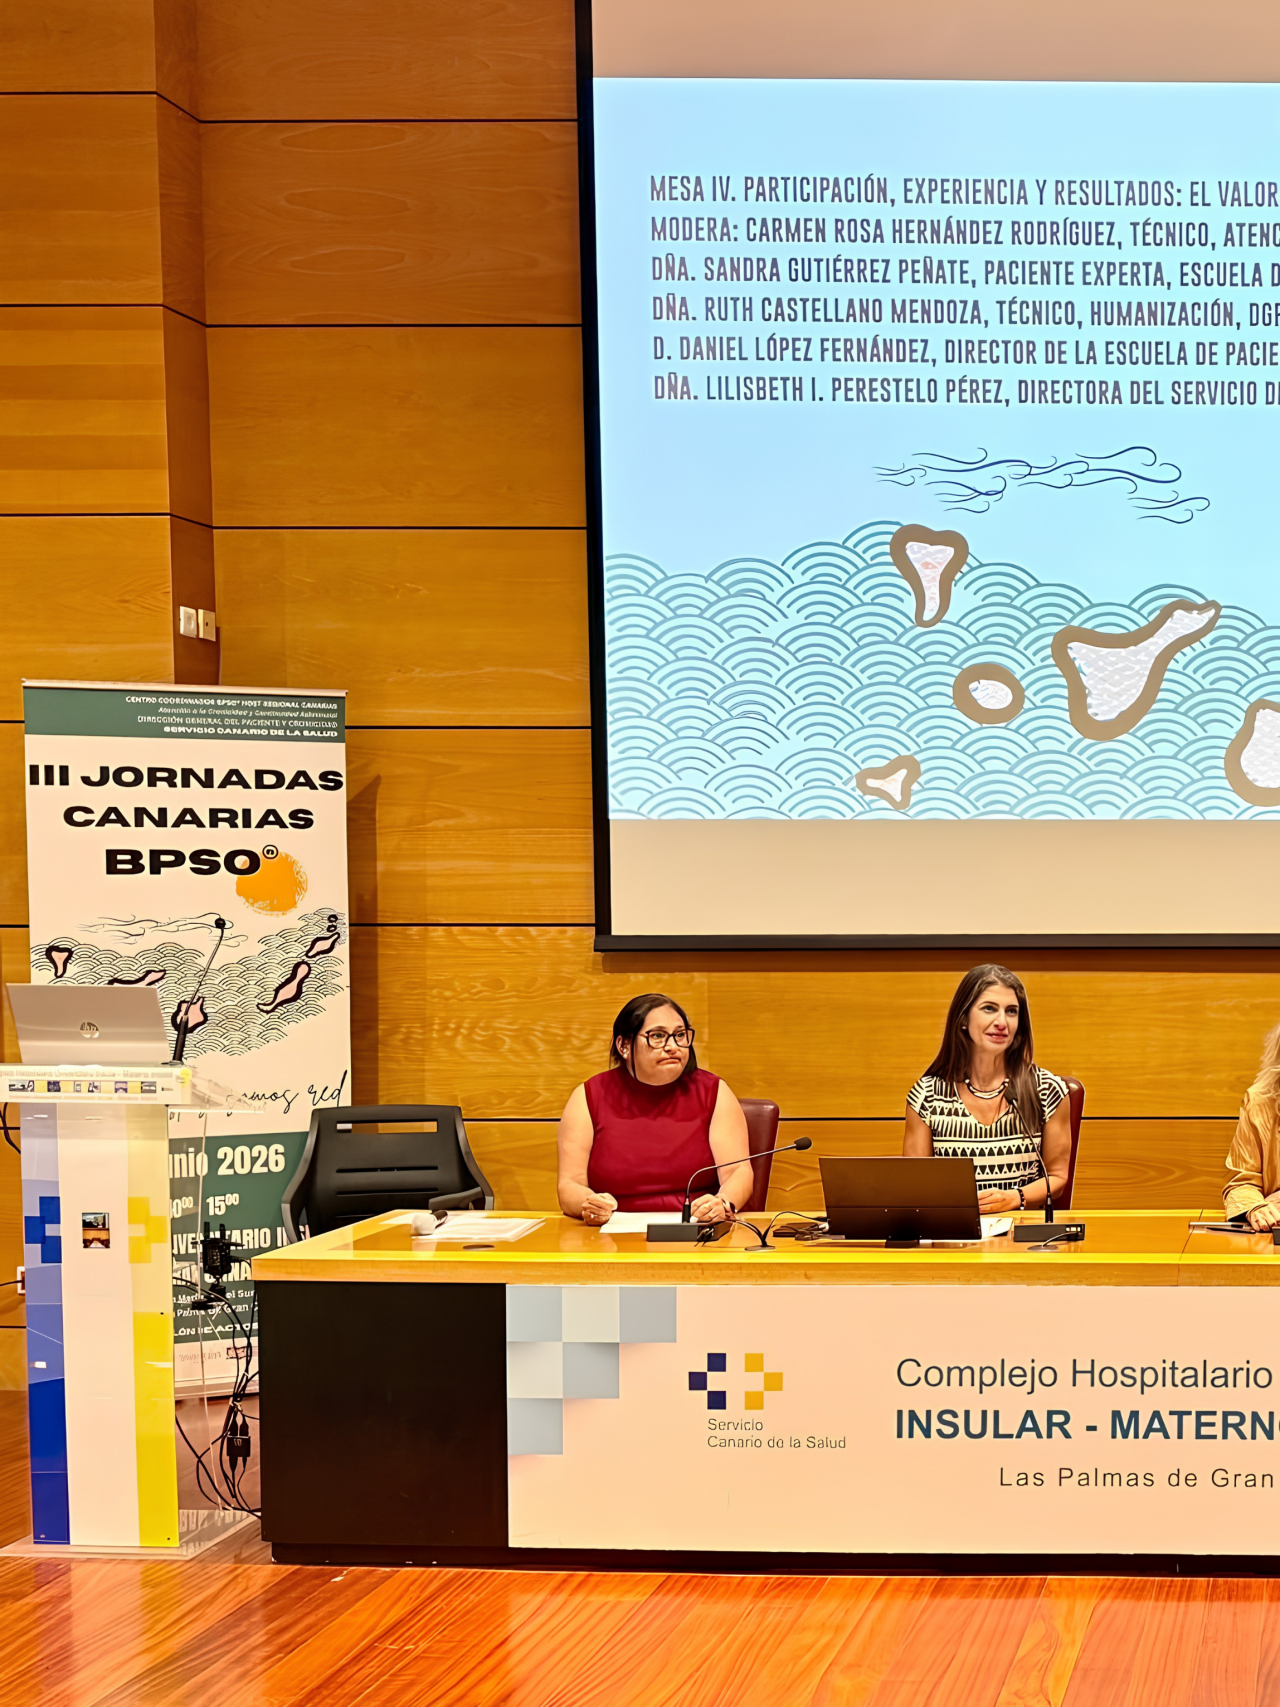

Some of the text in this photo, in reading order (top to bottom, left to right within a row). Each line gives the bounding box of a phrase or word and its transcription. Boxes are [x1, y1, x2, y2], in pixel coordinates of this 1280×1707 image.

[651, 176, 704, 201] MESA
[713, 176, 735, 201] IV.
[745, 173, 895, 207] PARTICIPACIÓN,
[904, 178, 1028, 205] EXPERIENCIA
[1036, 179, 1046, 205] Y
[1055, 180, 1181, 206] RESULTADOS:
[1191, 181, 1211, 206] EL
[1218, 181, 1278, 207] VALOR
[652, 217, 738, 241] MODERA:
[747, 217, 826, 242] CARMEN
[835, 218, 884, 243] ROSA
[893, 216, 1003, 244] HERNÁNDEZ
[1012, 217, 1121, 250] RODRÍGUEZ,
[1130, 218, 1215, 250] TÉCNICO,
[652, 253, 695, 281] DÑA.
[705, 257, 780, 281] SANDRA
[789, 254, 890, 283] GUTIÉRREZ
[899, 256, 976, 288] PEÑATE,
[985, 260, 1074, 285] PACIENTE
[1083, 262, 1171, 290] EXPERTA,
[1180, 262, 1262, 287] ESCUELA
[653, 293, 696, 320] DÑA.
[705, 297, 752, 321] RUTH
[762, 297, 882, 322] CASTELLANO
[892, 299, 988, 328] MENDOZA,
[996, 296, 1082, 329] TÉCNICO,
[1091, 298, 1240, 330] HUMANIZACIÓN,
[654, 336, 671, 360] D.
[680, 336, 748, 360] DANIEL
[756, 333, 812, 361] LÓPEZ
[821, 335, 936, 367] FERNÁNDEZ,
[946, 339, 1036, 364] DIRECTOR
[1045, 341, 1067, 364] DE
[1076, 340, 1097, 364] LA
[1106, 341, 1187, 365] ESCUELA
[1196, 342, 1218, 365] DE
[655, 372, 698, 400] DÑA.
[707, 376, 803, 401] LILISBETH
[812, 377, 823, 401] I.
[832, 378, 937, 402] PERESTELO
[946, 375, 1009, 407] PÉREZ,
[1019, 380, 1122, 404] DIRECTORA
[1131, 381, 1164, 404] DEL
[1172, 381, 1256, 405] SERVICIO
[29, 764, 344, 791] III JORNADAS
[63, 805, 314, 830] CANARIAS
[217, 1143, 286, 1176] 2026
[897, 1359, 1057, 1395] Complejo
[1073, 1359, 1272, 1395] Hospitalario
[897, 1409, 1072, 1439] INSULAR
[807, 1436, 846, 1449] Salud
[1001, 1468, 1044, 1486] Las
[1059, 1468, 1154, 1487] Palmas
[1168, 1468, 1197, 1487] de
[1212, 1468, 1273, 1488] Gran
